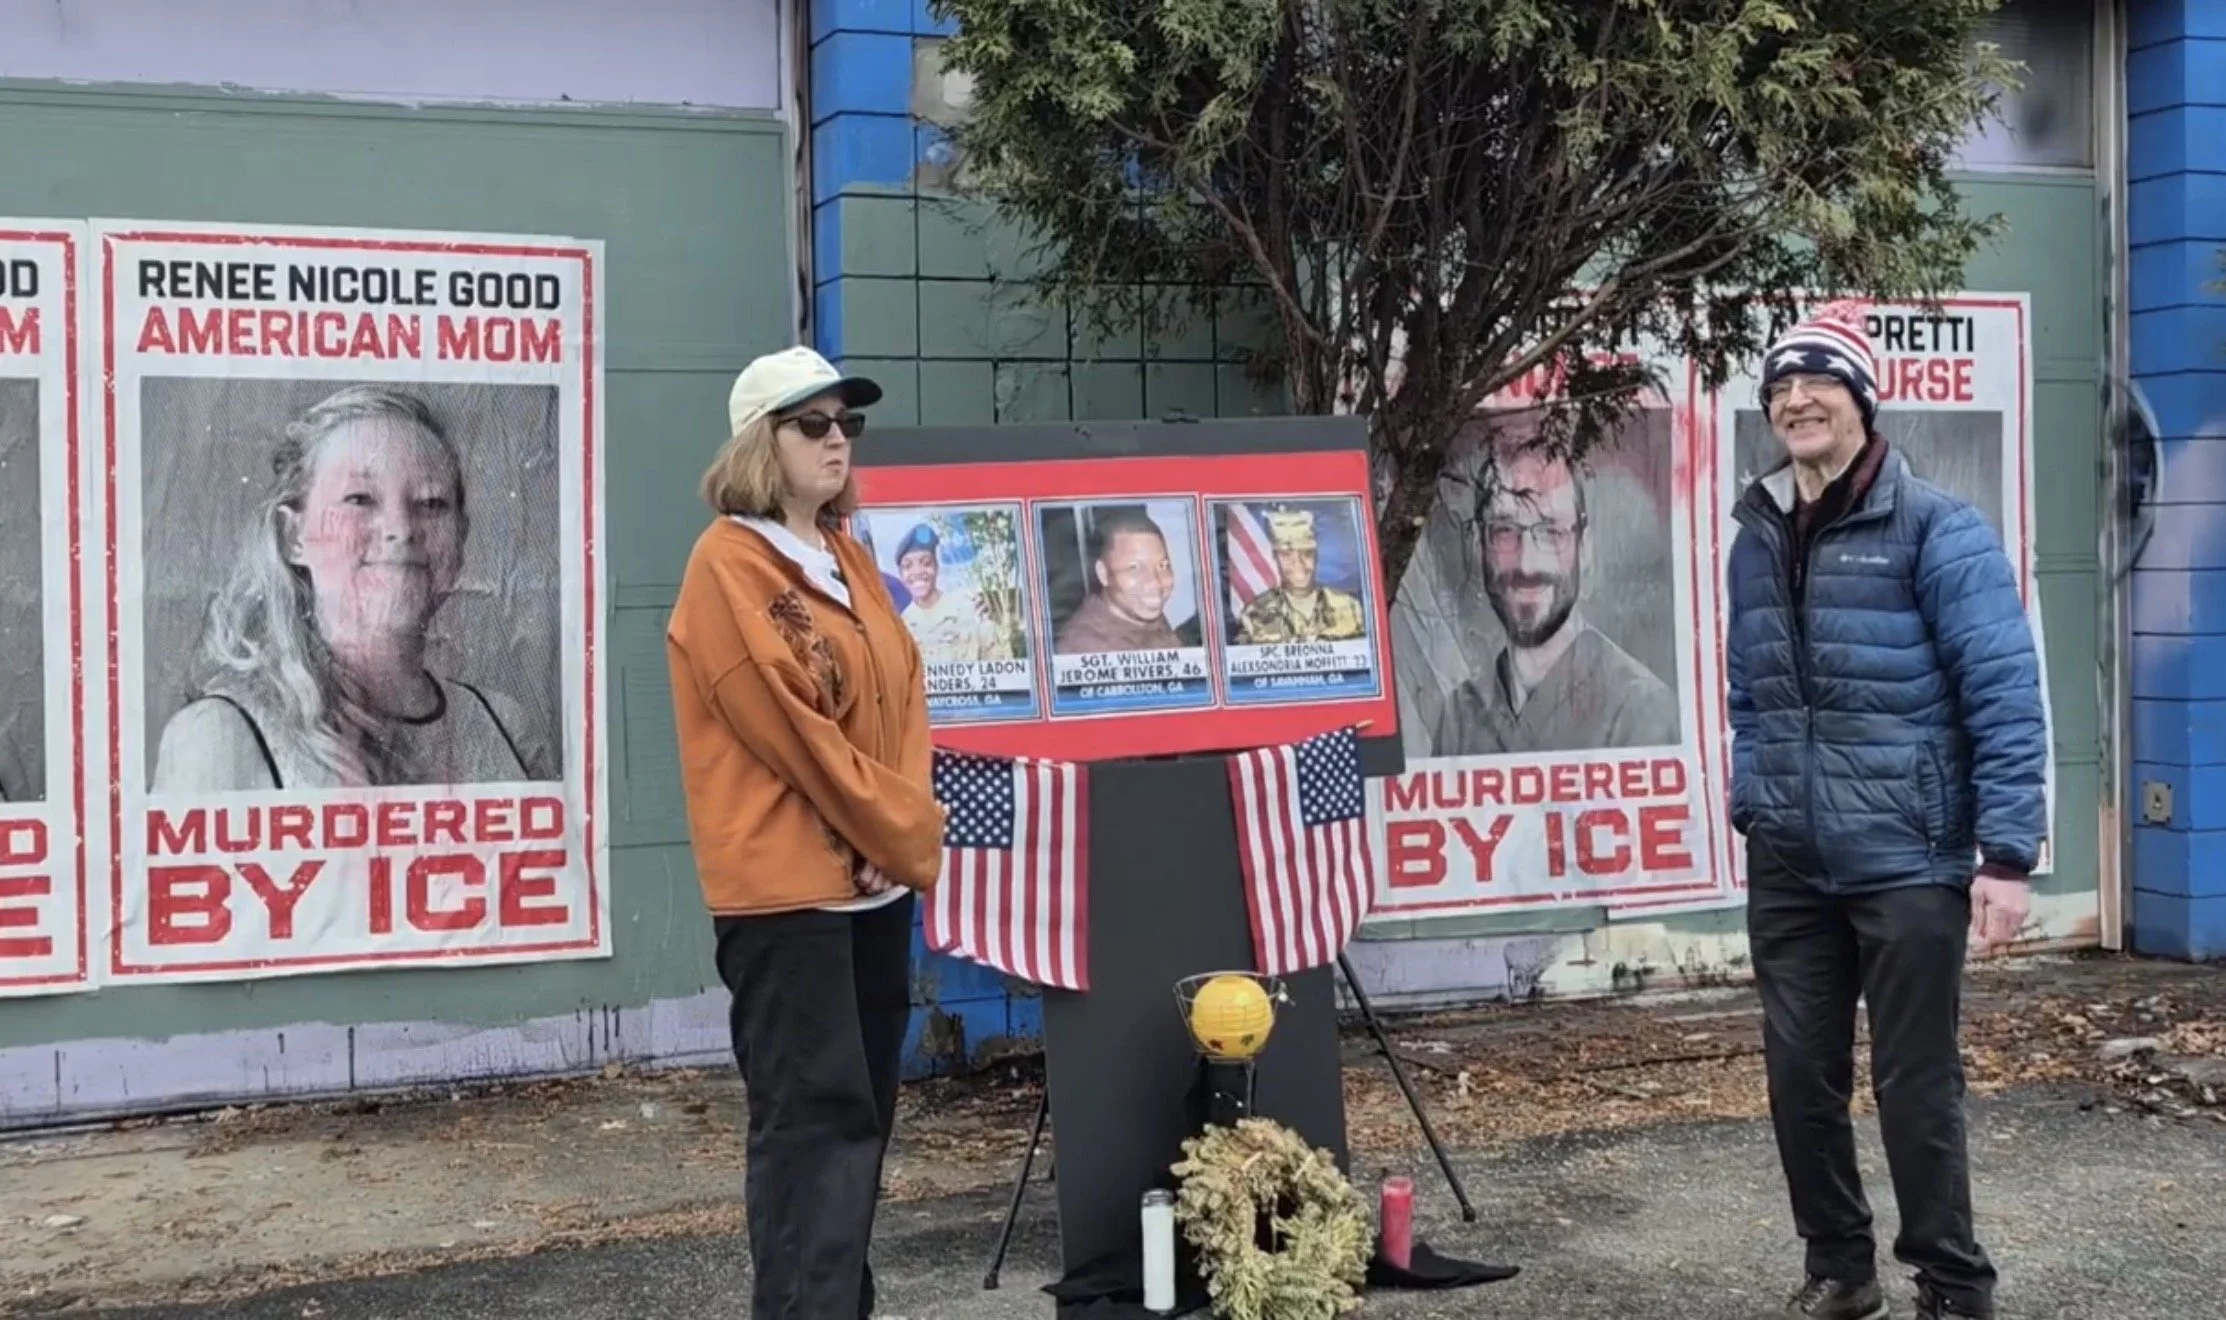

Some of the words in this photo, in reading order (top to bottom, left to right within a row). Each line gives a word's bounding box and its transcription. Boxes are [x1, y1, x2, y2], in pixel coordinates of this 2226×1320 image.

[138, 259, 276, 300] RENEE
[289, 265, 437, 305] NICOLE
[448, 270, 560, 310] GOOD
[137, 307, 421, 359] AMERICAN
[437, 316, 562, 363] MOM
[1865, 315, 1974, 352] PRETTI
[1876, 358, 1974, 401] URSE
[927, 663, 973, 677] NNEDY
[980, 661, 1026, 675] LADON
[1060, 667, 1117, 683] JEROME
[1123, 664, 1178, 680] RIVERS,
[1182, 663, 1202, 675] 46
[1081, 654, 1112, 668] SGT.
[1117, 651, 1179, 666] WILLIAM
[980, 676, 997, 689] 24
[1166, 681, 1185, 693] GA
[1384, 759, 1686, 811] MURDERED
[147, 796, 566, 856] MURDERED
[1387, 815, 1511, 888] BY
[1547, 805, 1692, 878] ICE
[148, 860, 325, 945] BY
[369, 850, 568, 936] ICE
